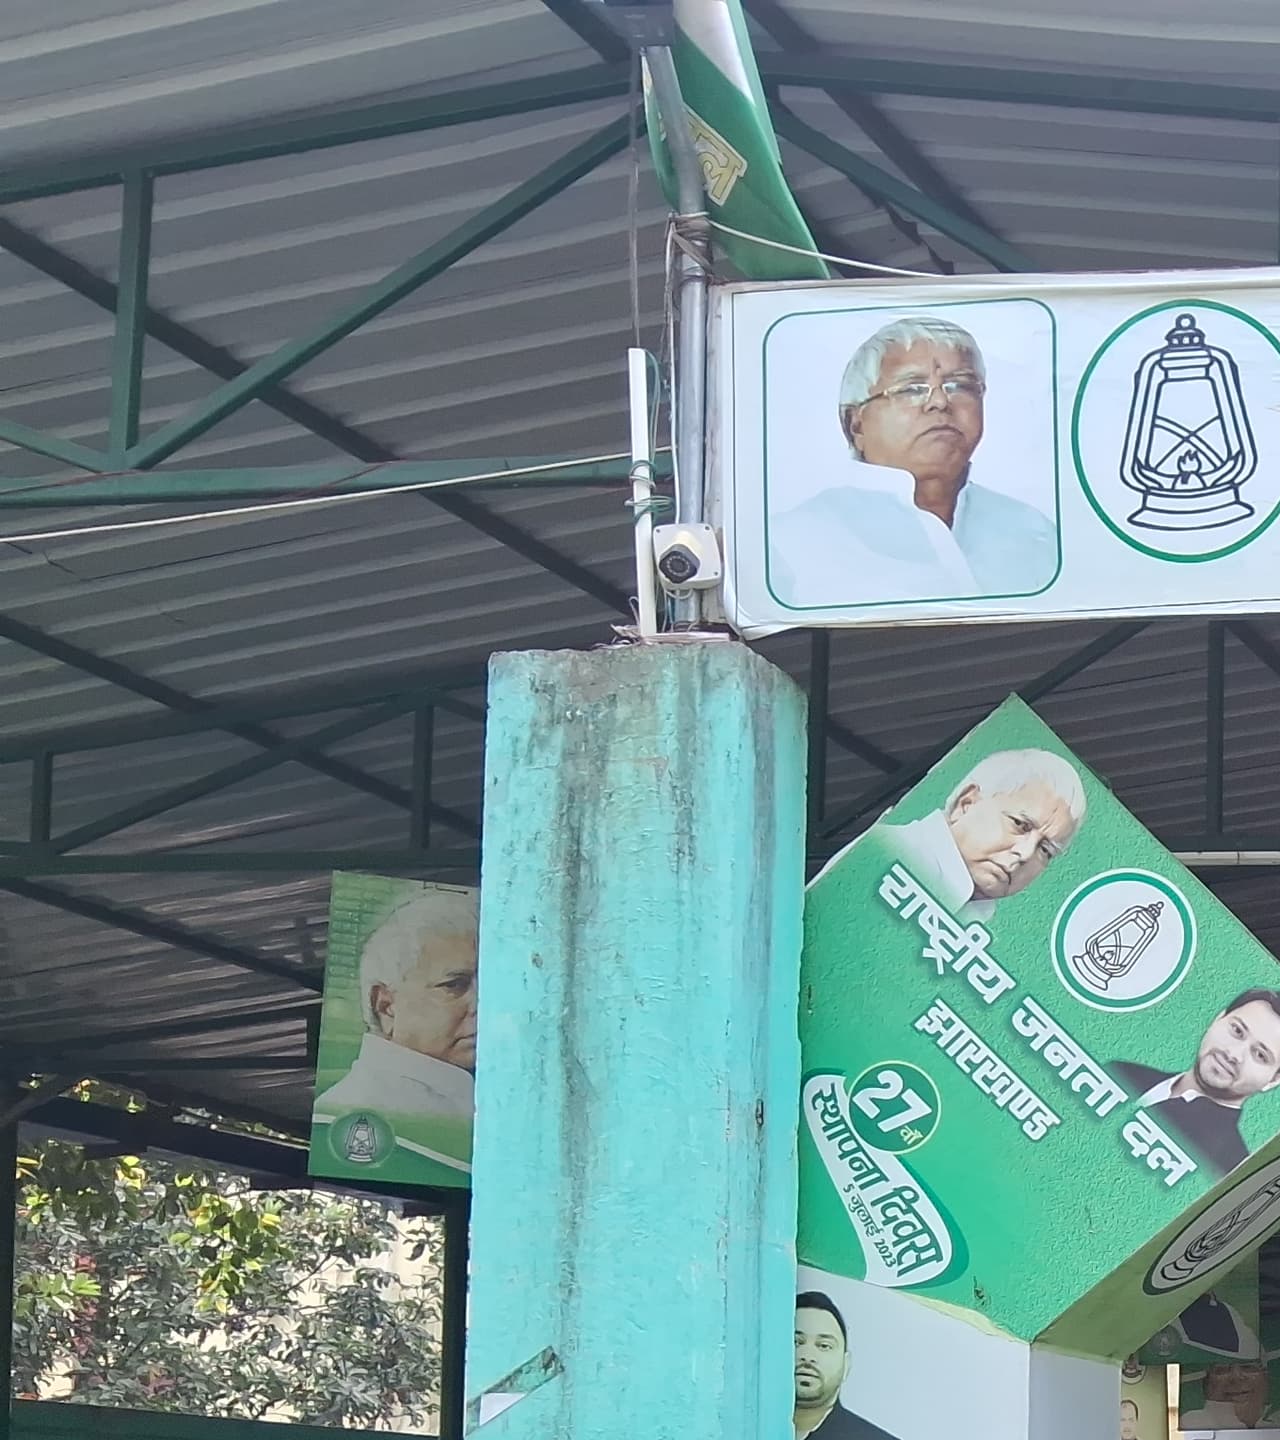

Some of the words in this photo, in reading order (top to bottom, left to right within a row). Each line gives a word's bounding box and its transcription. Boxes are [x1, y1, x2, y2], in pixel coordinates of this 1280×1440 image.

[878, 863, 1017, 1005] राष्ट्रीय
[1011, 996, 1129, 1117] जनता
[1122, 1109, 1198, 1188] दल
[914, 999, 1062, 1141] झारखण्ड
[853, 1070, 932, 1133] 27
[811, 1082, 890, 1191] स्थापना
[870, 1185, 943, 1278] दिवस
[843, 1183, 855, 1193] 5
[849, 1195, 885, 1237] जुलाई
[874, 1238, 896, 1268] 2023
